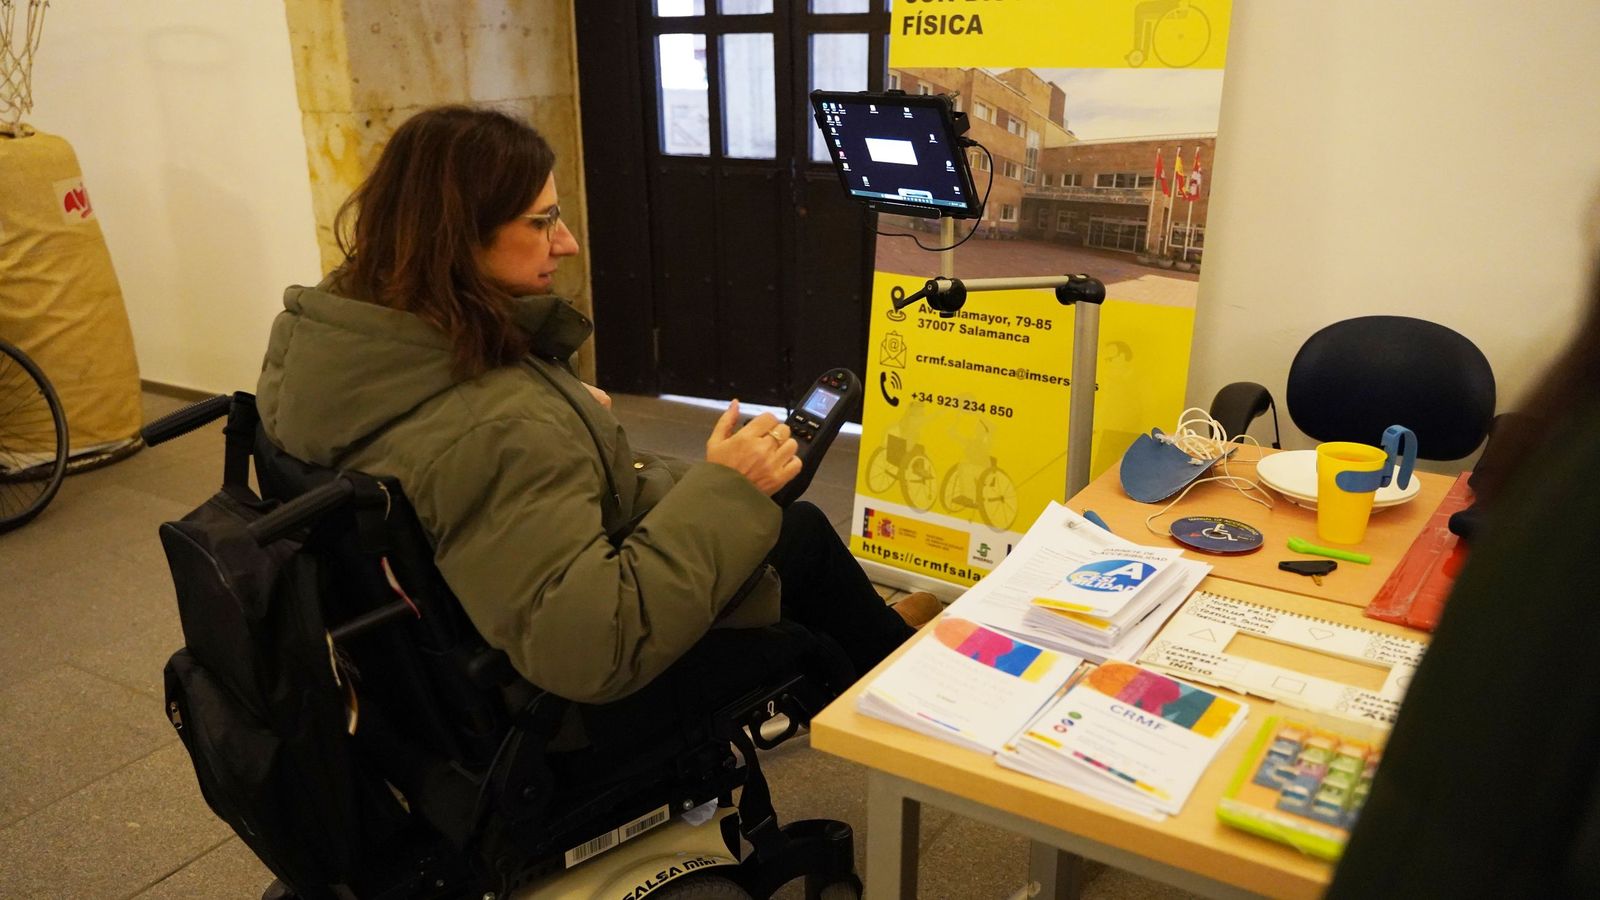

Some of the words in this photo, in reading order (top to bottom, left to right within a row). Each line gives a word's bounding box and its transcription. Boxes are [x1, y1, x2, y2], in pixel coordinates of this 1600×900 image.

[903, 10, 984, 36] FÍSICA
[918, 303, 937, 315] Av.
[952, 306, 1012, 327] lamayor,
[1015, 315, 1053, 331] 79-85
[917, 318, 956, 333] 37007
[959, 323, 1031, 344] Salamanca
[911, 392, 933, 403] +34
[937, 395, 960, 409] 923
[962, 400, 986, 413] 234
[989, 404, 1014, 418] 850
[862, 541, 985, 582] https://crmfsala
[1168, 661, 1213, 676] INICIO
[1109, 704, 1169, 731] CRMF
[623, 866, 683, 900] SALSA
